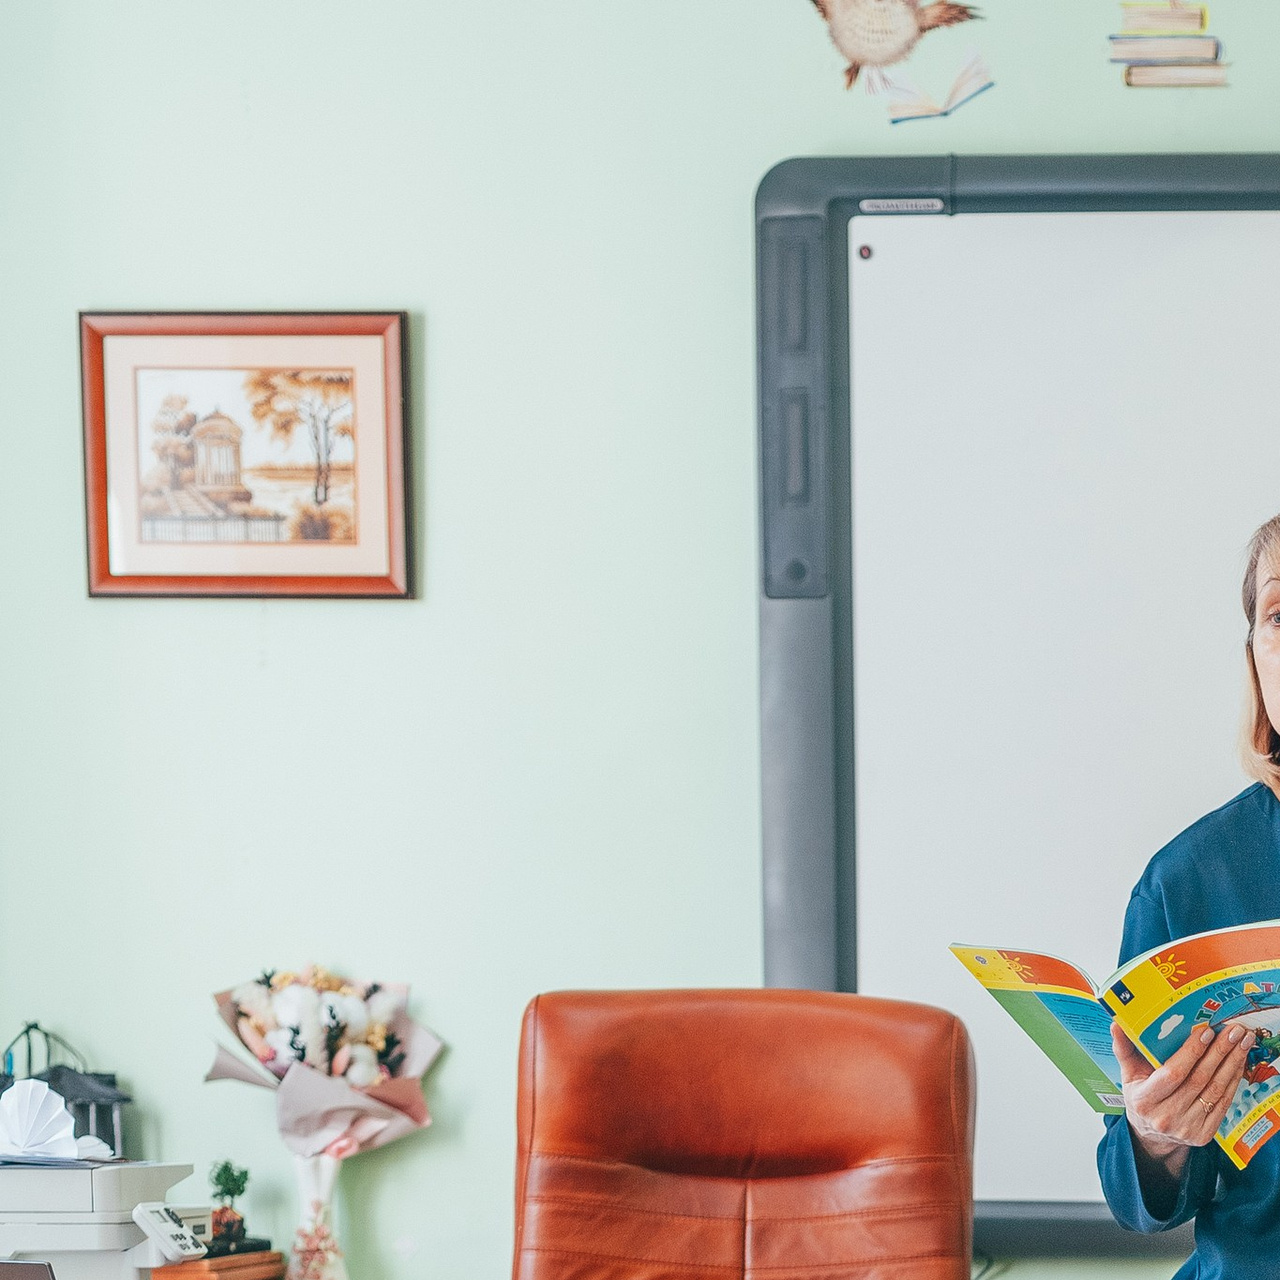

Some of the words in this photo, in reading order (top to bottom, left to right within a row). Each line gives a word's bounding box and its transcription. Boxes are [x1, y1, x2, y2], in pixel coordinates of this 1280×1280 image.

[1168, 977, 1213, 1003] УЧУСЬ
[1219, 975, 1254, 989] Петерсон
[1245, 1119, 1265, 1139] ЧАСТЬ
